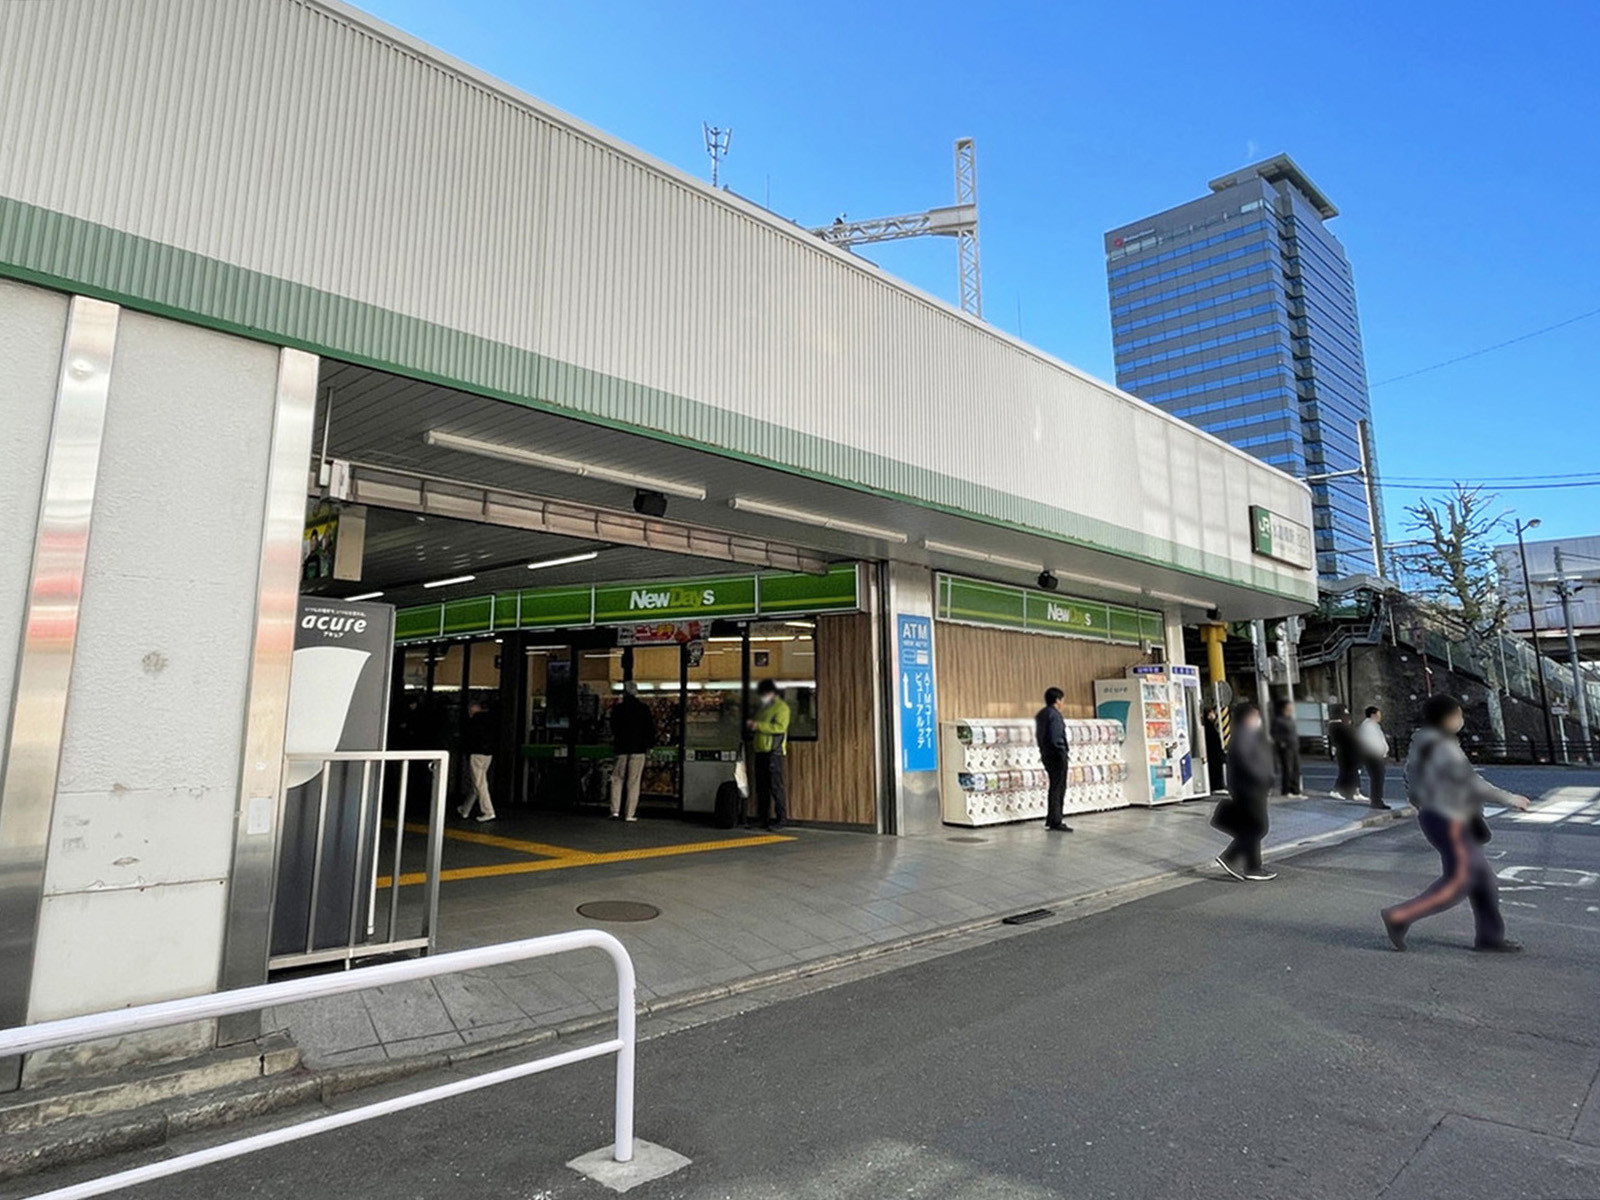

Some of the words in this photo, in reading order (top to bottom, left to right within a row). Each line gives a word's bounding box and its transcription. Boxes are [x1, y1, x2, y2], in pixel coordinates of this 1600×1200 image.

[1258, 516, 1270, 533] JR
[629, 588, 715, 610] NewDays
[301, 614, 367, 633] acure
[902, 622, 928, 640] ATM
